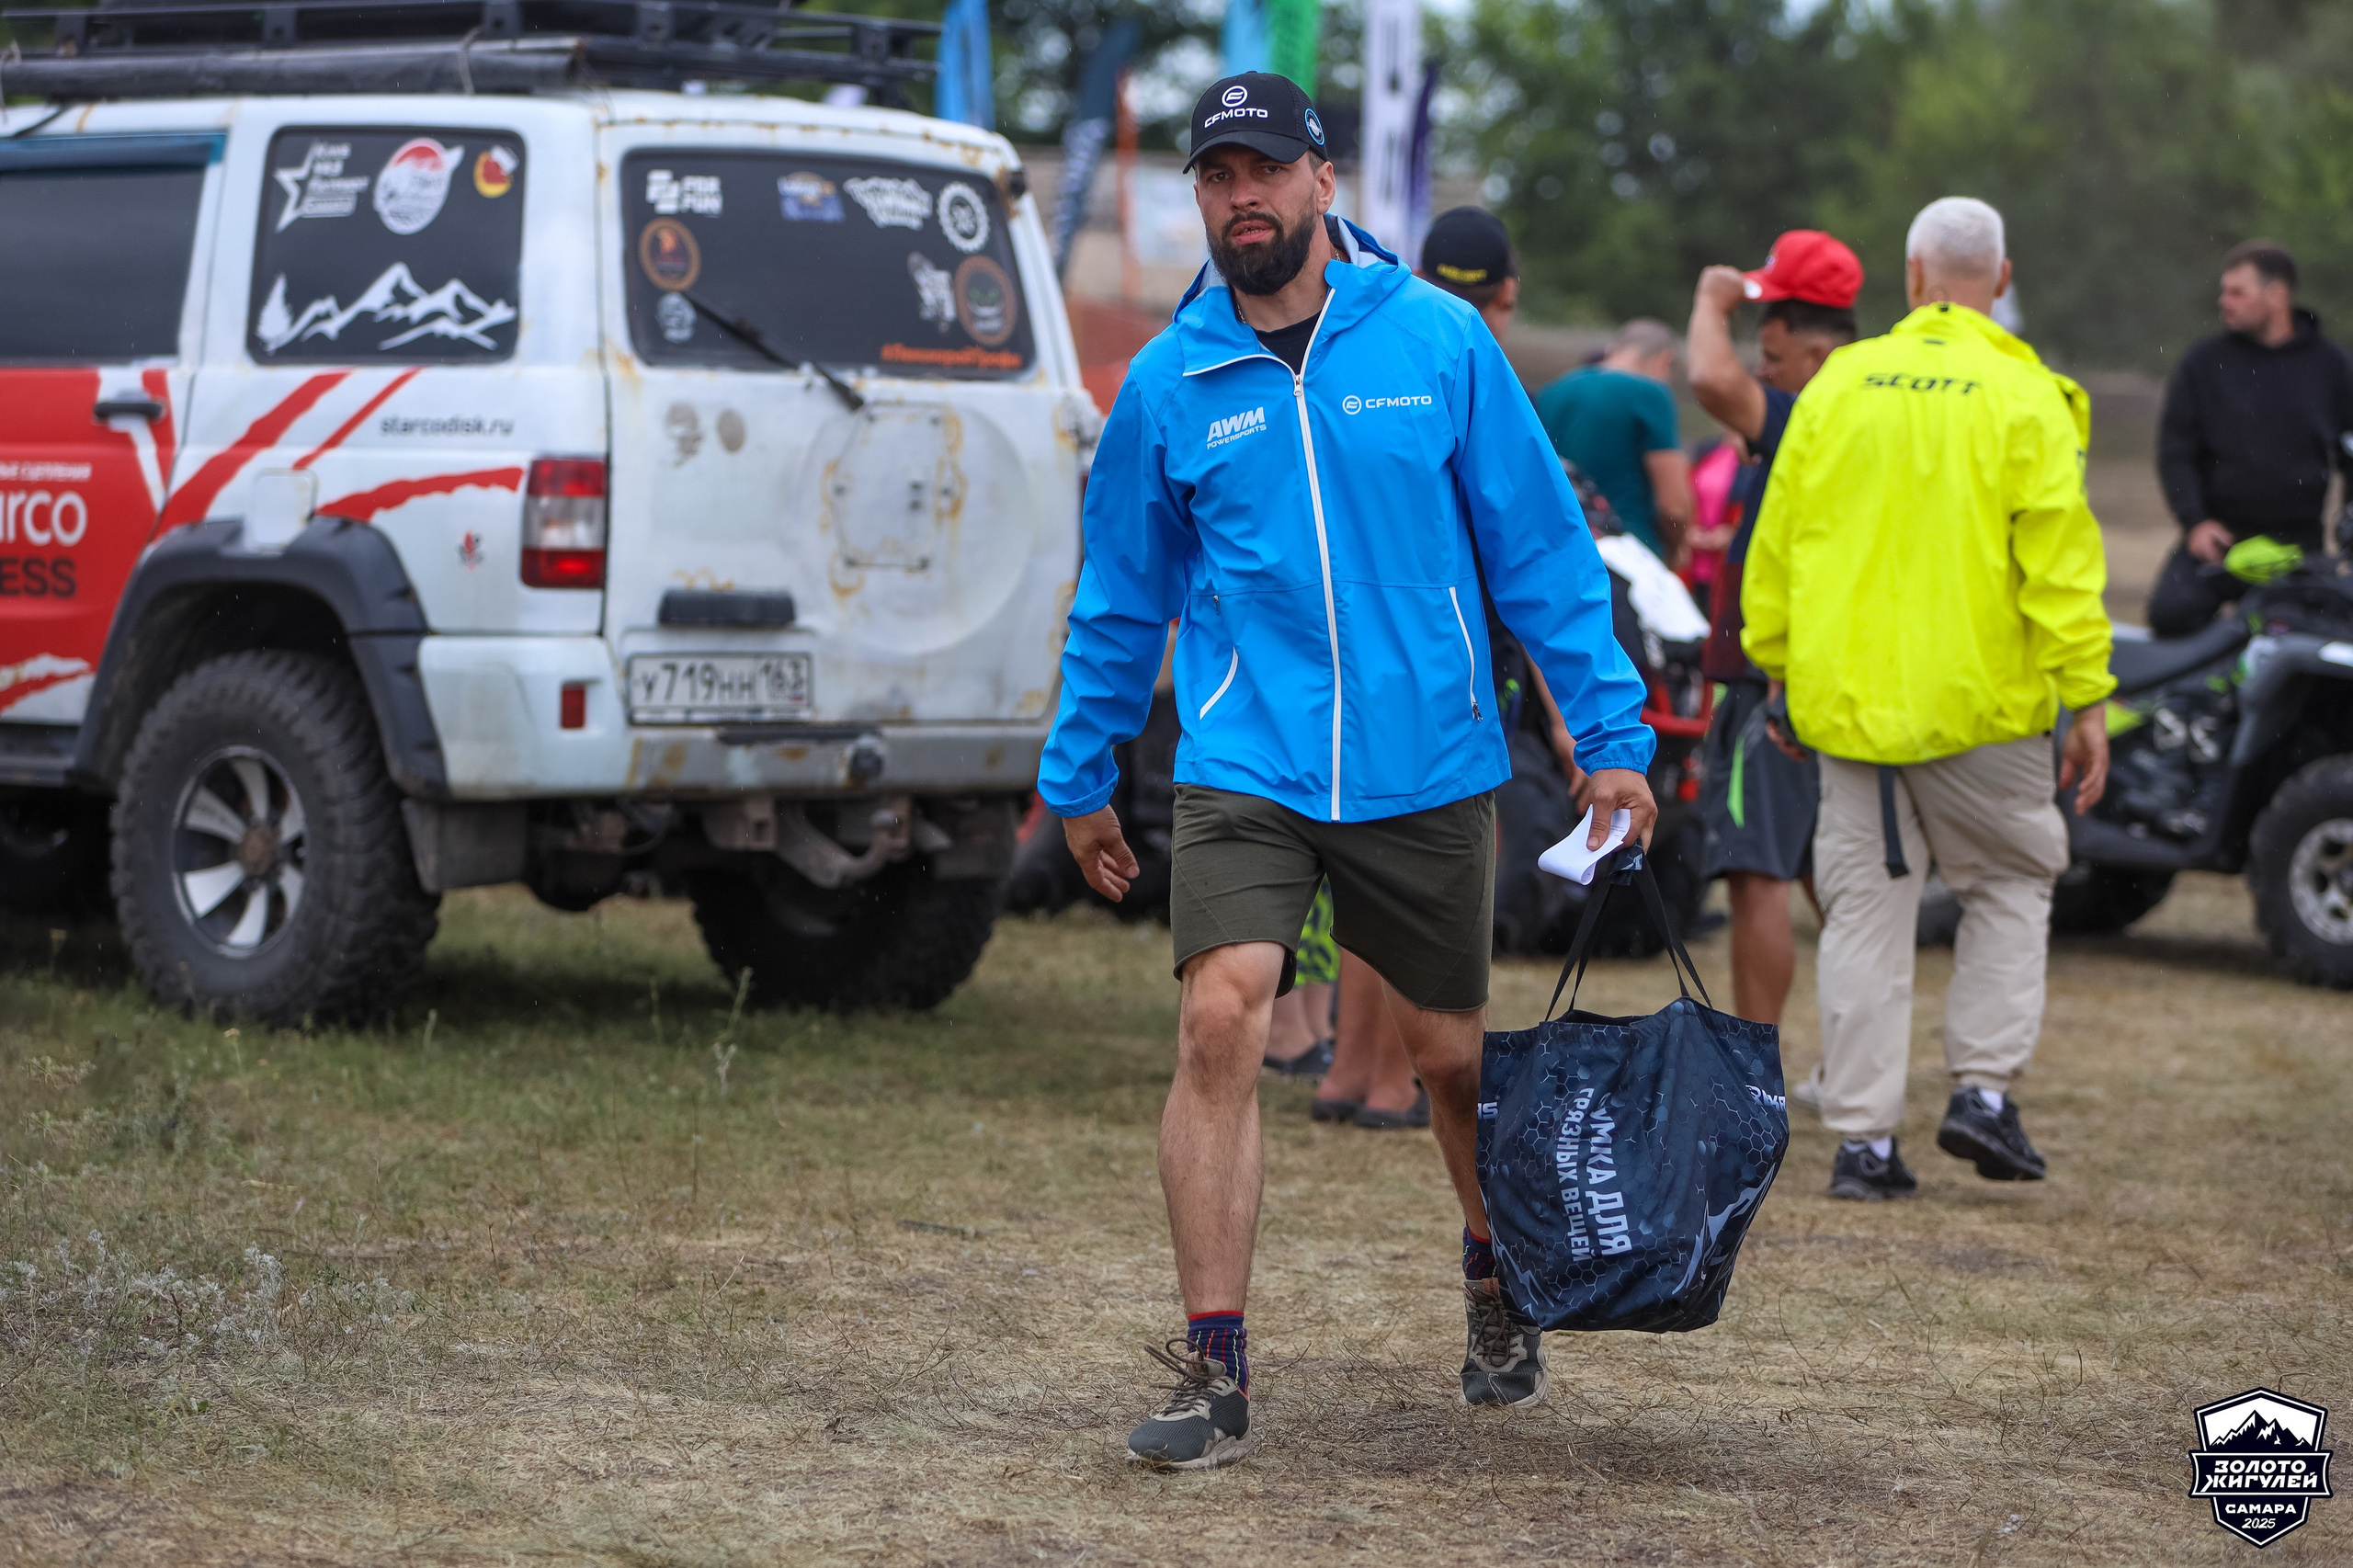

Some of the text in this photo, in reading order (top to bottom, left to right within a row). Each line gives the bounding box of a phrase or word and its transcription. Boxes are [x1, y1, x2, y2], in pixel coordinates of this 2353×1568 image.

[1204, 108, 1268, 129] CFMOTO
[1365, 395, 1432, 409] CFMOTO
[1207, 406, 1265, 442] AWM
[1207, 424, 1267, 450] POWERSPORTS
[0, 489, 88, 547] rco
[1556, 1087, 1597, 1262] ГРЯЗНЫХ ВЕЩЕЙ
[1585, 1191, 1633, 1256] ДЛЯ
